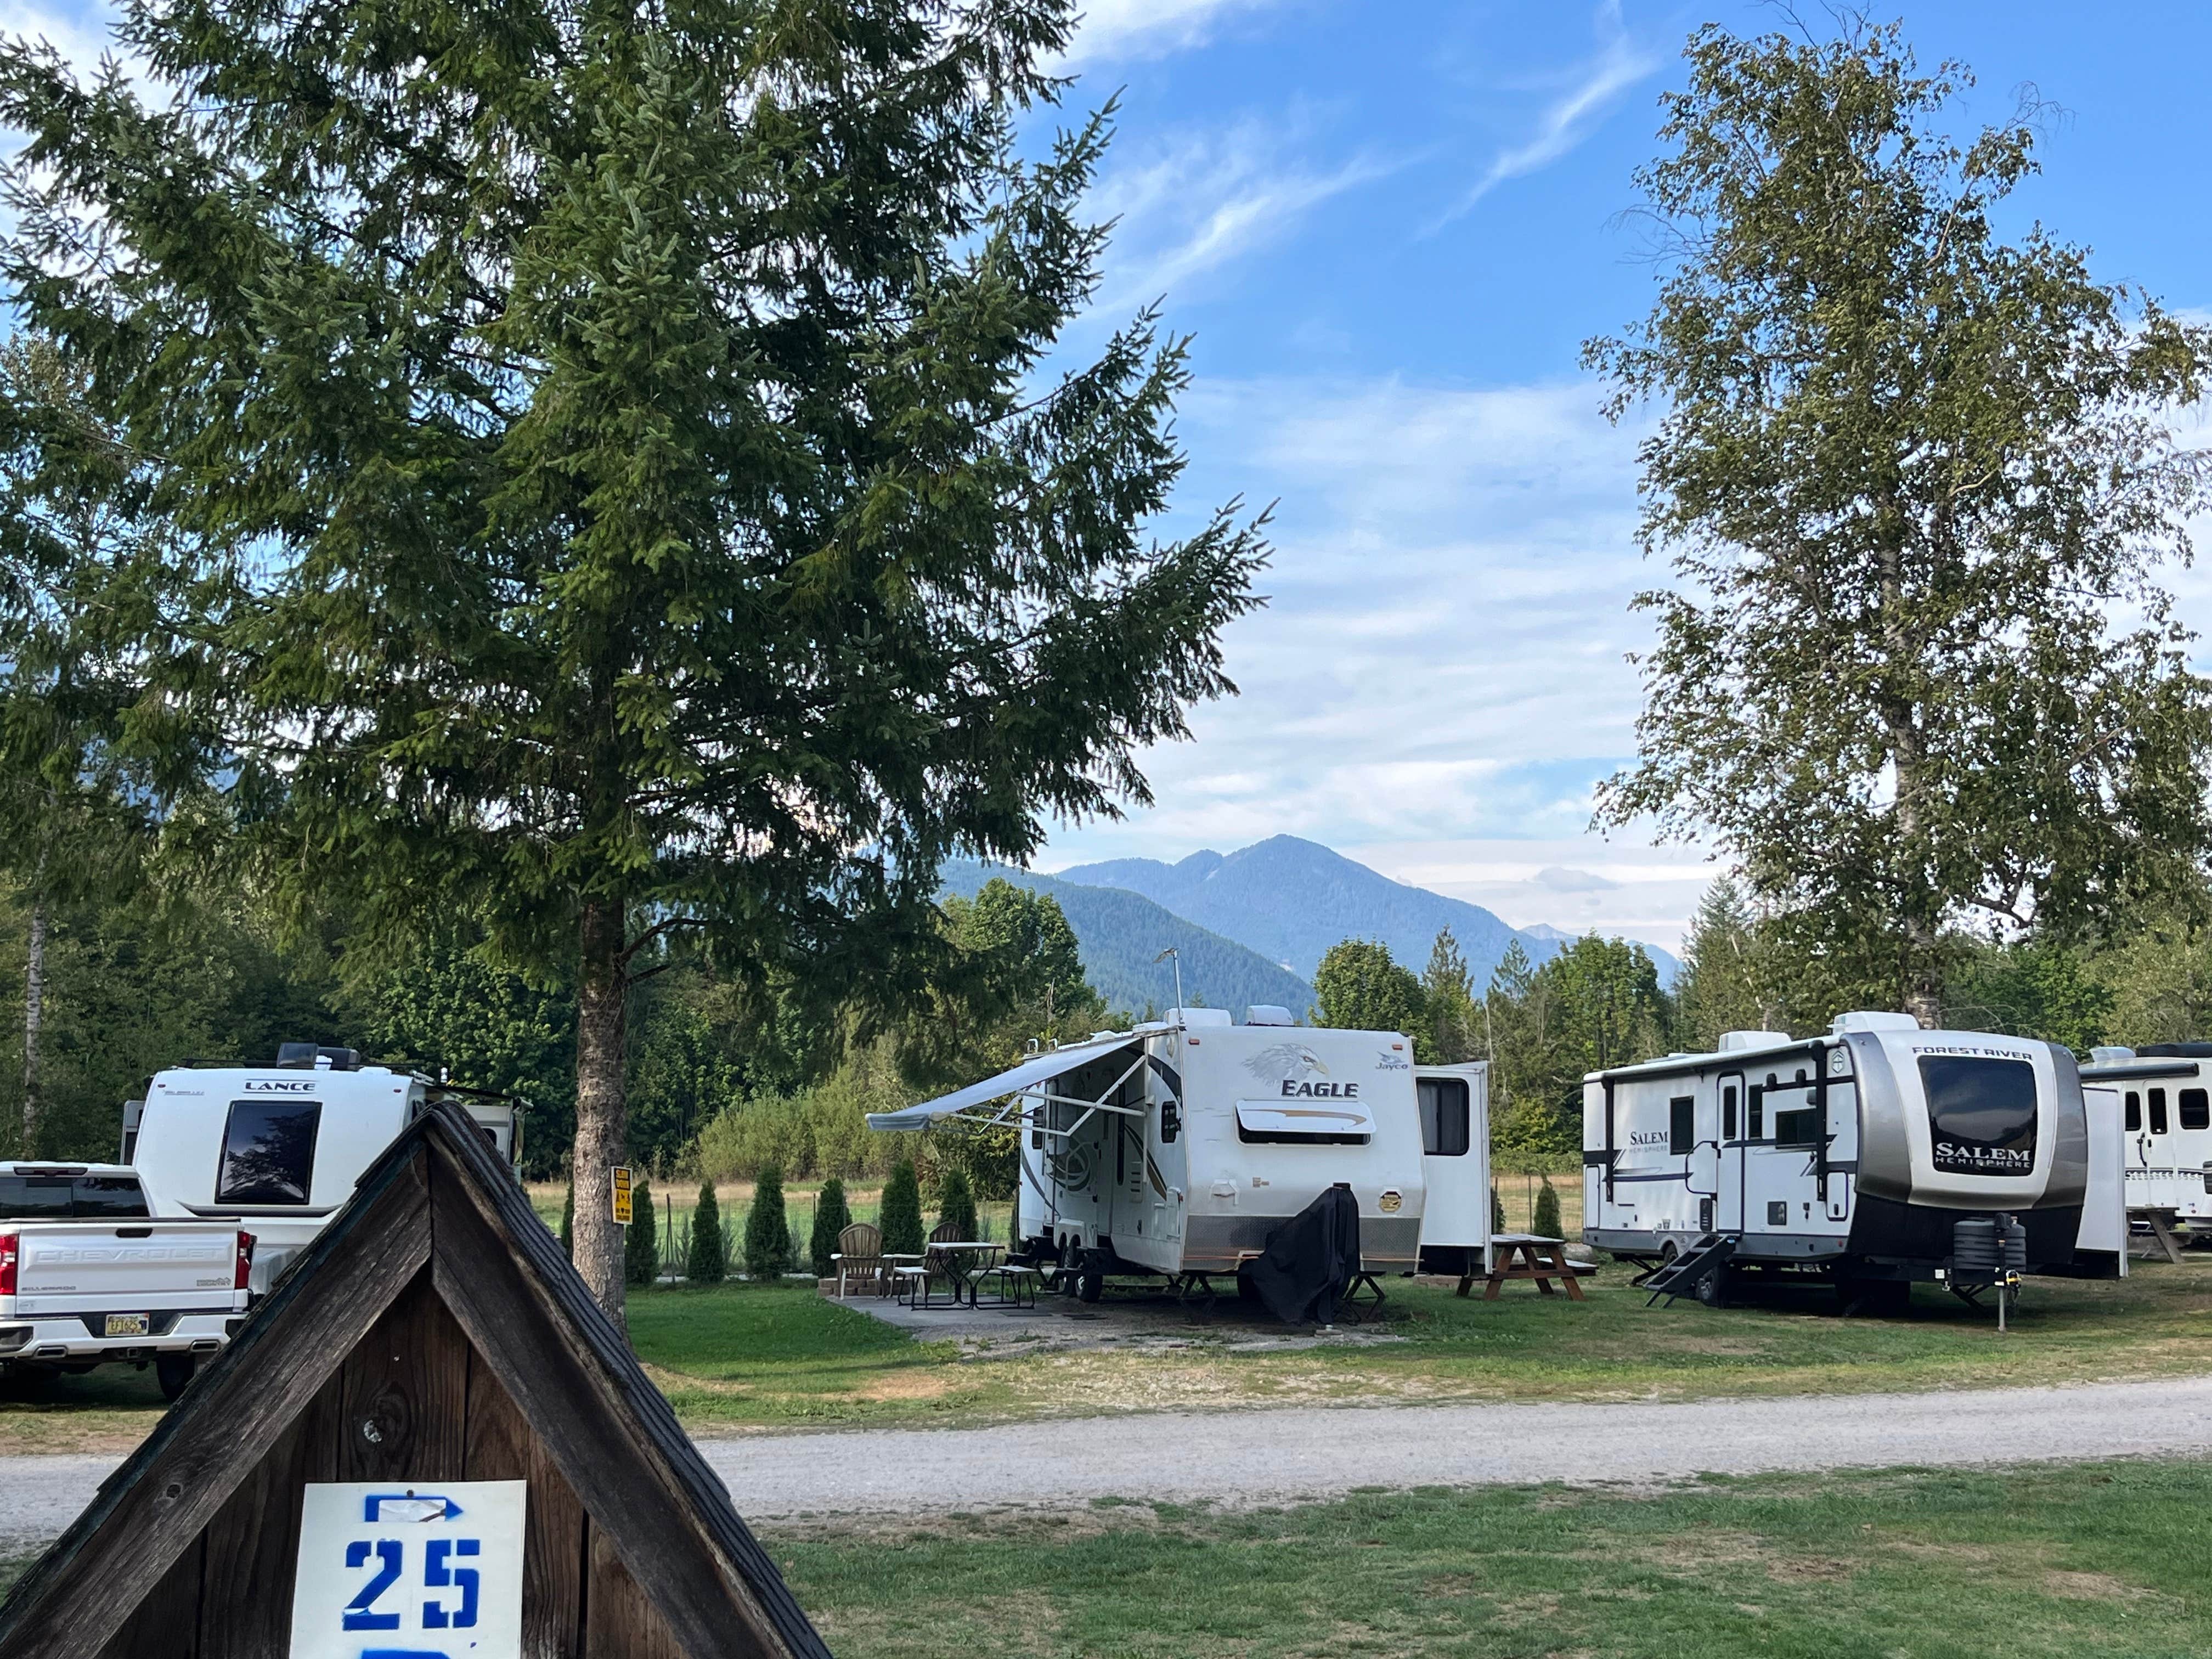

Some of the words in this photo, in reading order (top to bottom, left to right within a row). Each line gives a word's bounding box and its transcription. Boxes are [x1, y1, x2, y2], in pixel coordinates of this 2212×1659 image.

[1984, 1048, 2033, 1060] RIVER
[245, 1082, 317, 1091] LANCE
[1281, 1079, 1359, 1098] EAGLE
[1630, 1131, 1668, 1146] SALEM
[1936, 1142, 2030, 1161] SALEM
[1935, 1156, 2030, 1168] HEMISPHERE
[36, 1248, 227, 1262] CHEVROLET
[342, 1538, 480, 1631] 25
